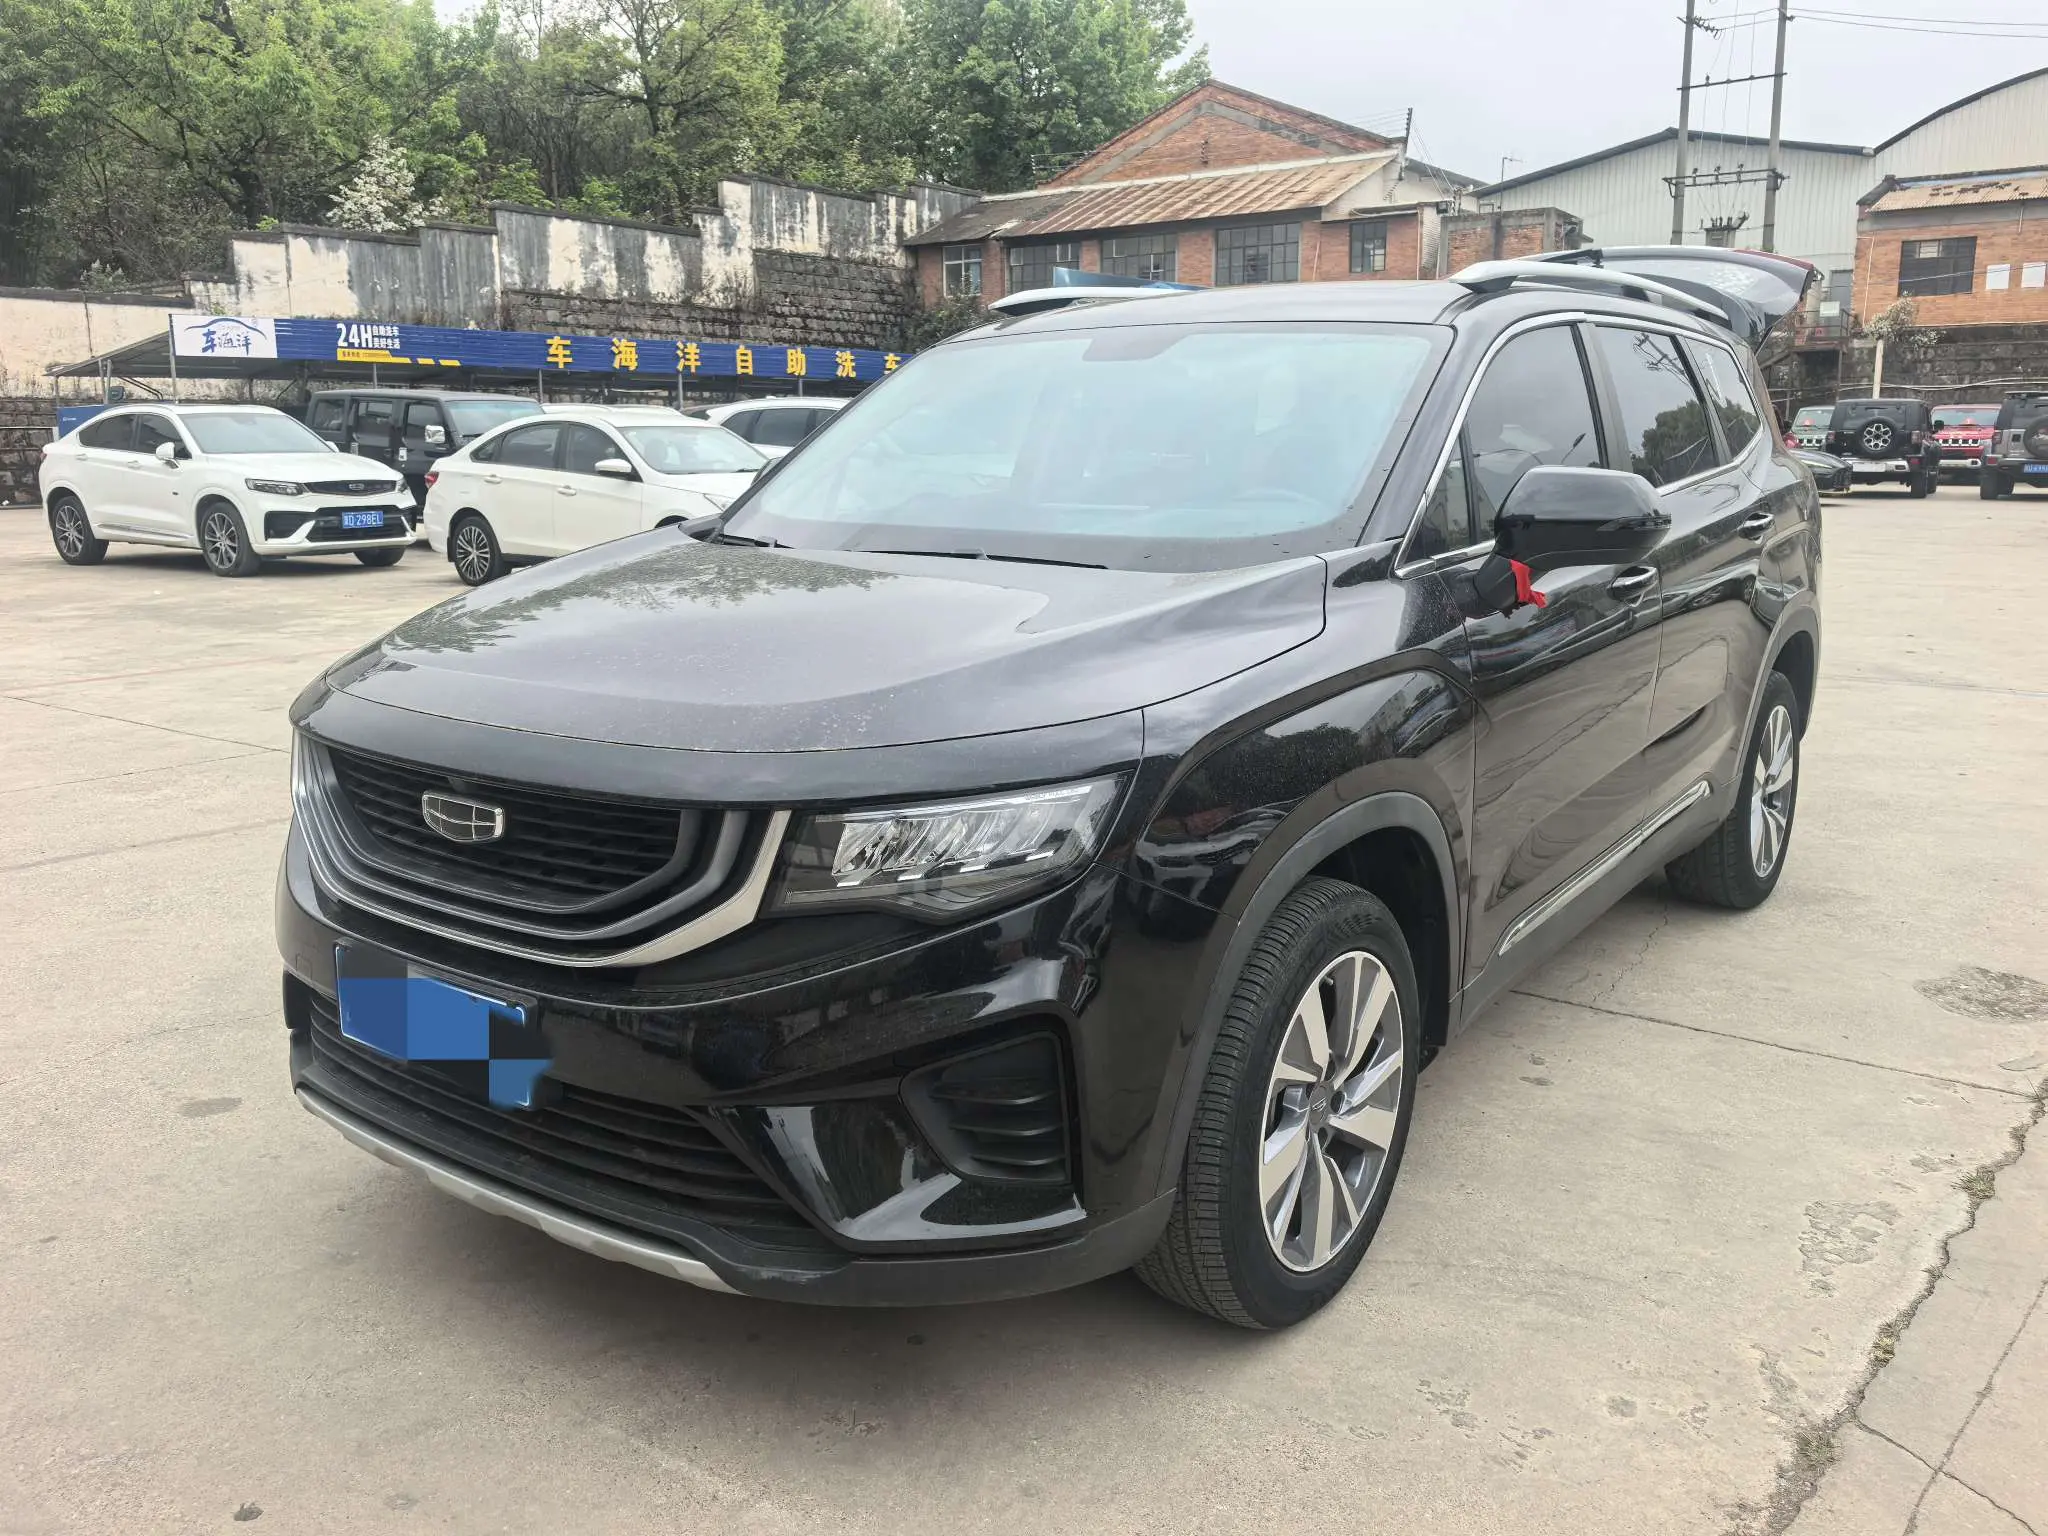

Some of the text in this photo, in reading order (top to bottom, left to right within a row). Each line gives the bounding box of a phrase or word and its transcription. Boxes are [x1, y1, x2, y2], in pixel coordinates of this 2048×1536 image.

[201, 328, 252, 357] 车海洋
[336, 323, 373, 348] 24H
[546, 335, 902, 378] 车海洋自助洗车
